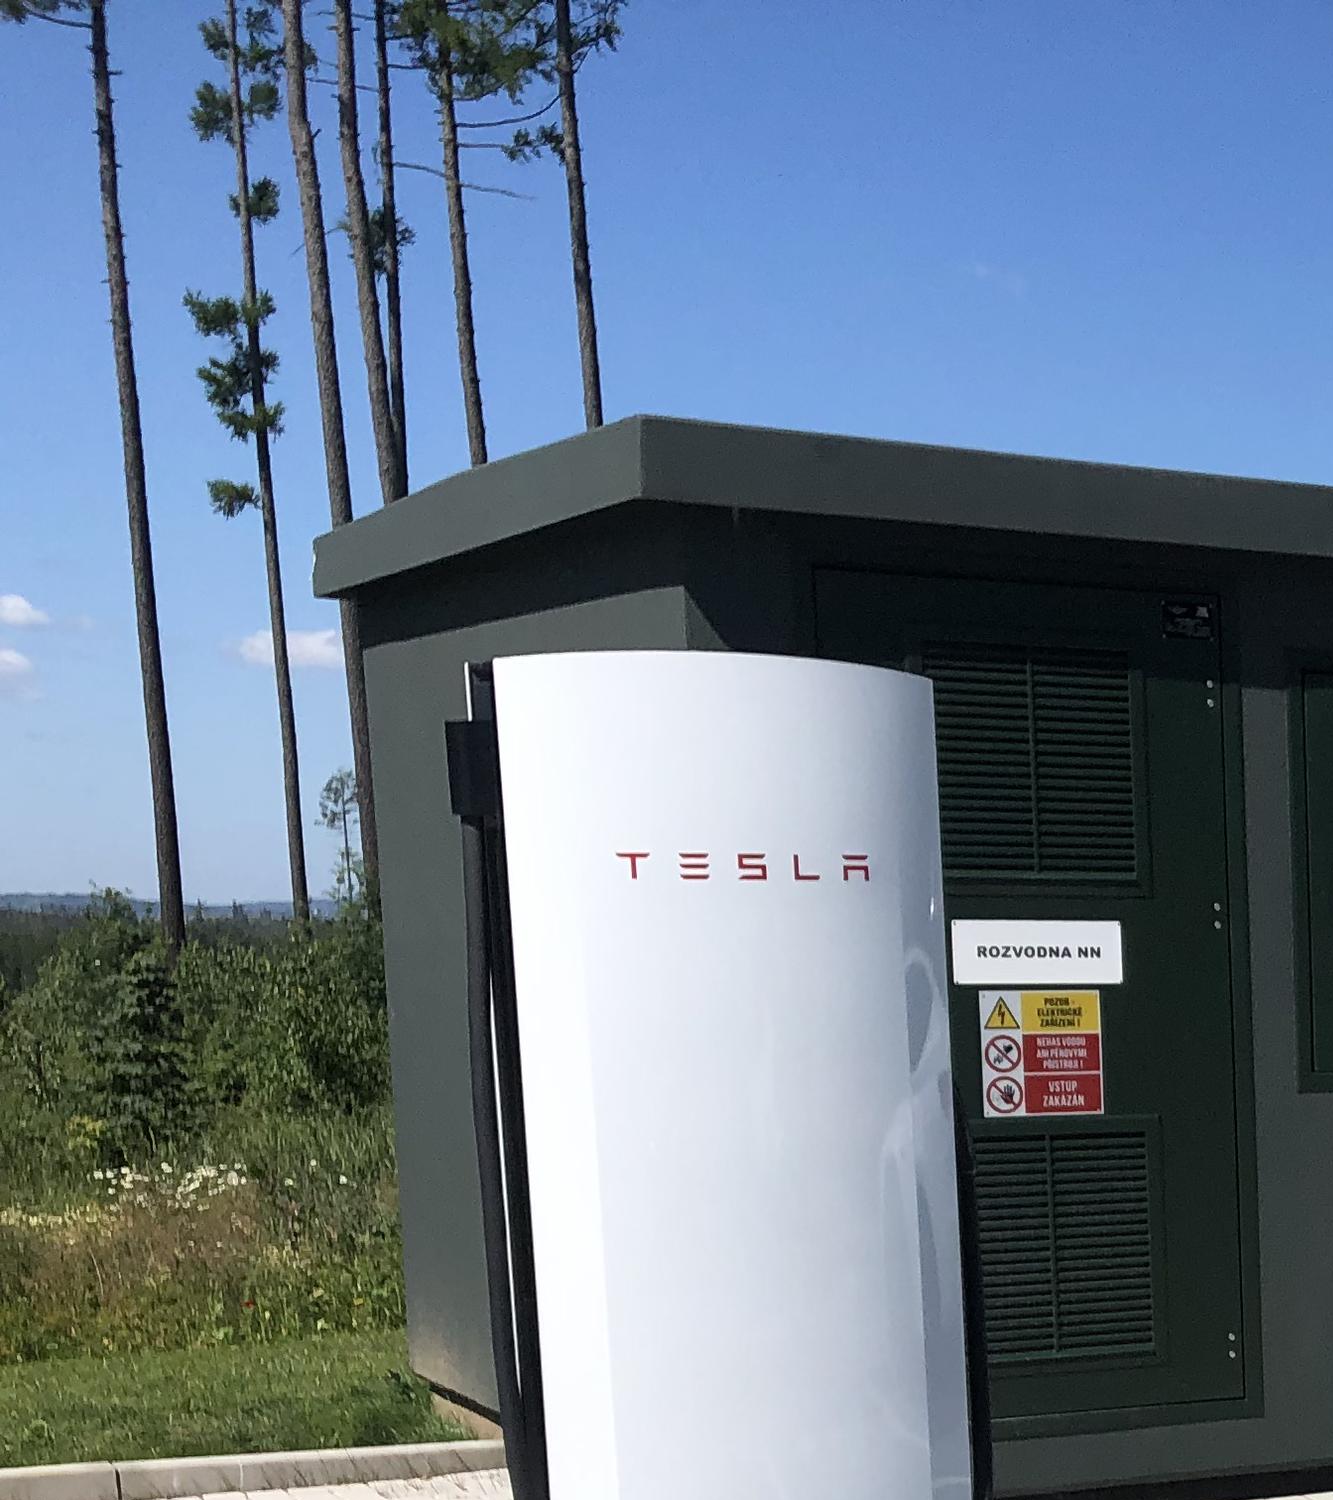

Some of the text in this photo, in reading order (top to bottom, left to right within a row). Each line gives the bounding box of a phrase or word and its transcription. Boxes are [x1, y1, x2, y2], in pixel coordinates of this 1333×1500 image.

[615, 852, 870, 882] TESLA
[976, 945, 1101, 959] ROZVODNA NN
[1048, 1080, 1078, 1093] VSTUP
